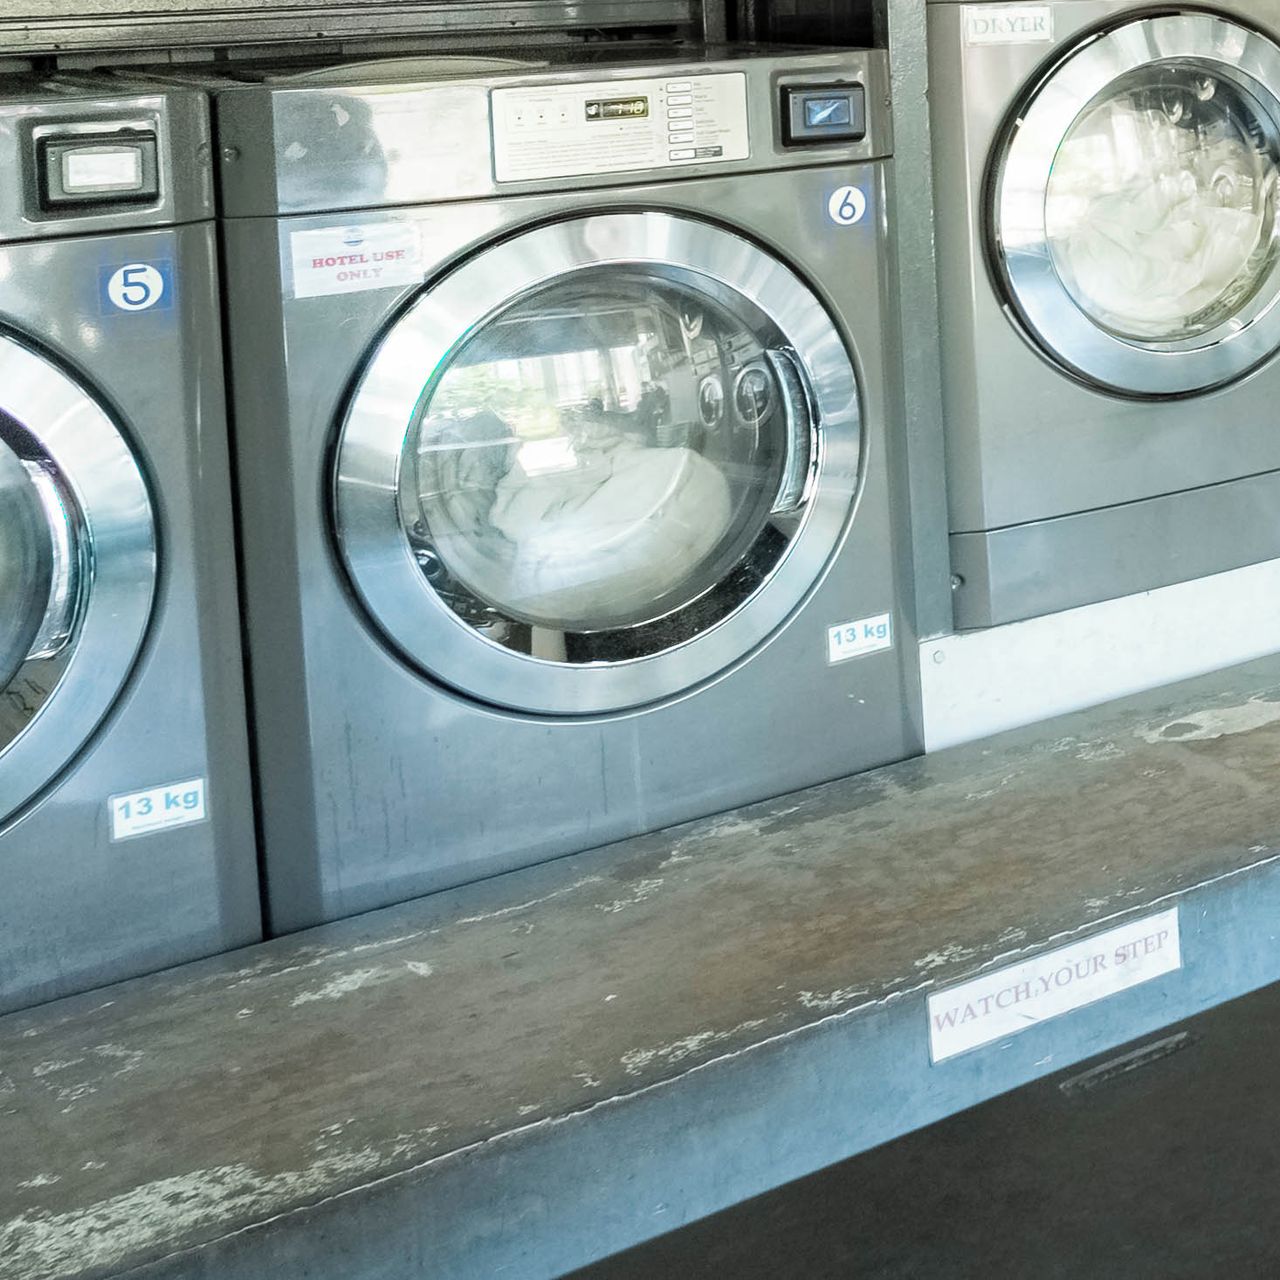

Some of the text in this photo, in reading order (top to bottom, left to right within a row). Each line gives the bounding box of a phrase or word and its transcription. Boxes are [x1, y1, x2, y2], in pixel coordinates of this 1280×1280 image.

[973, 16, 1046, 34] DRYER
[839, 190, 855, 220] 6
[312, 249, 406, 269] HOTEL USE
[121, 266, 151, 306] 5
[336, 267, 384, 282] ONLY
[833, 623, 887, 646] 13 kg
[118, 790, 199, 820] 13 kg
[933, 931, 1169, 1032] WATCH YOUR STEP
